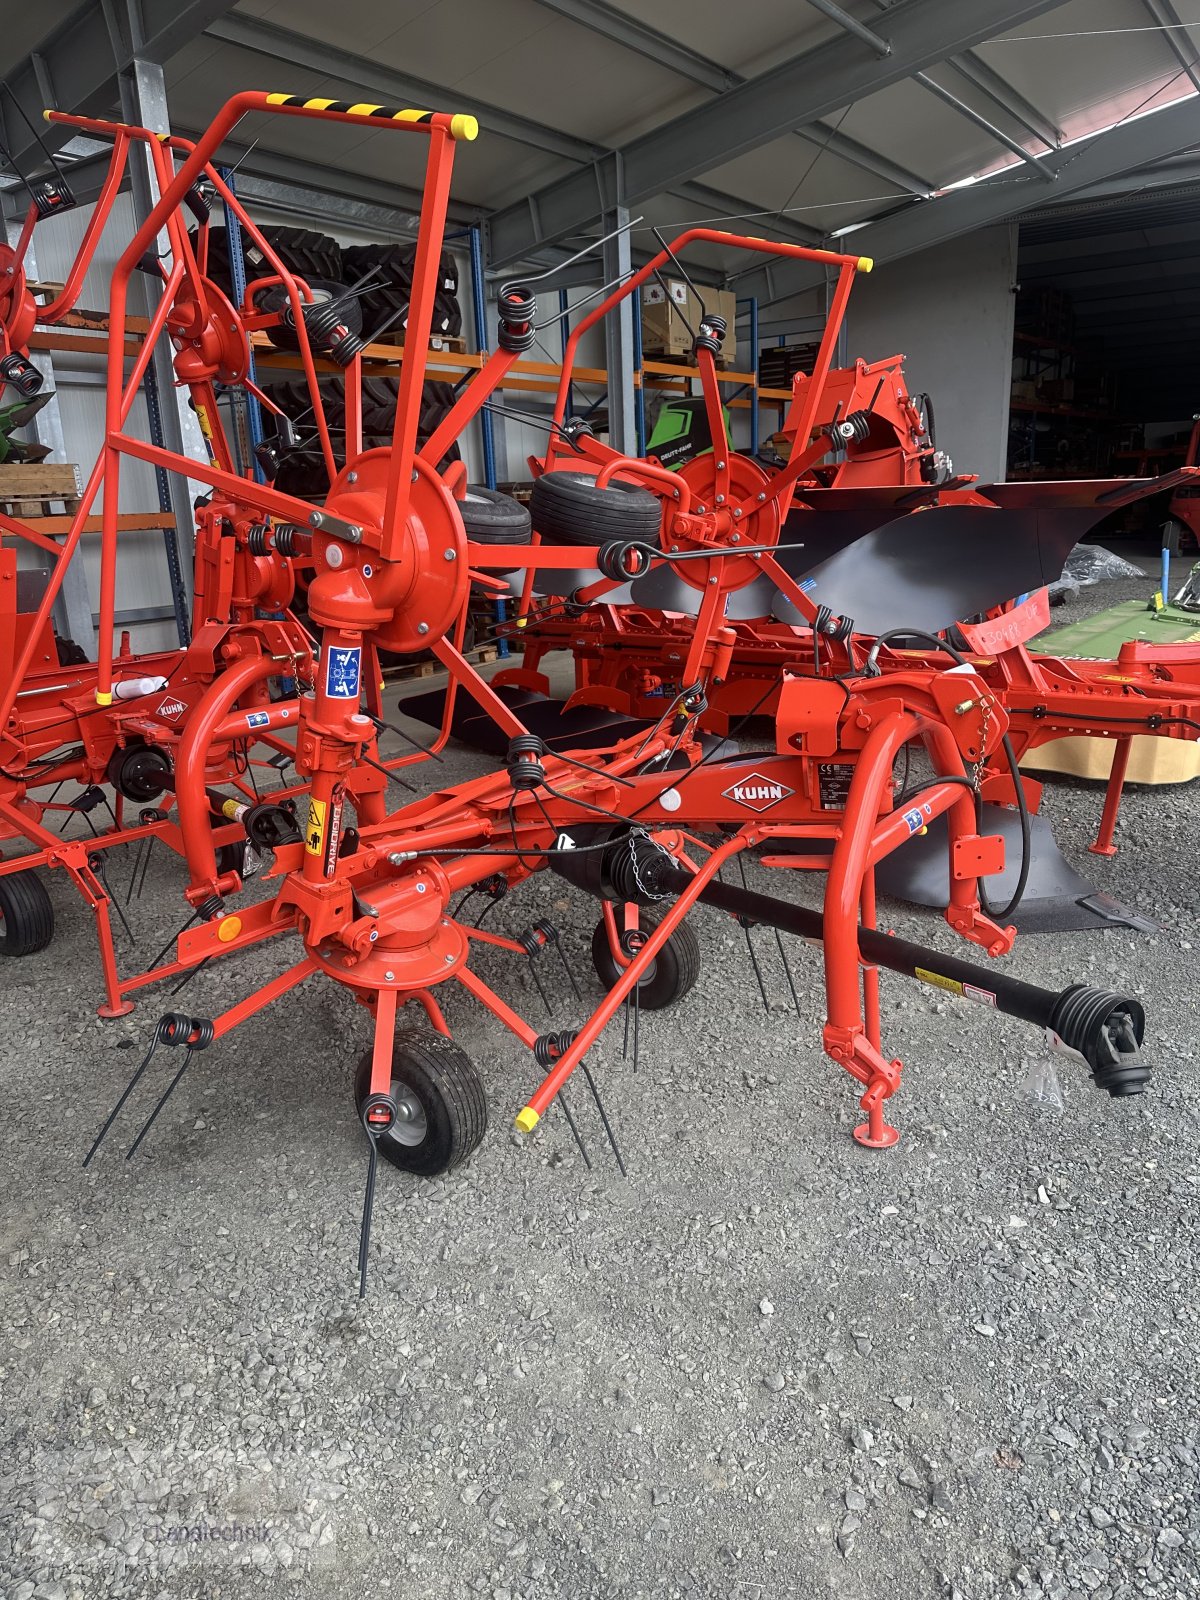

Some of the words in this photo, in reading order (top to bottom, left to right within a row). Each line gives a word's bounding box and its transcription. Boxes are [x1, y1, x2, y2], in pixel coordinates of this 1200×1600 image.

[160, 702, 184, 716] KUHN
[733, 785, 783, 800] KUHN
[327, 807, 342, 874] DIGIDRIVE
